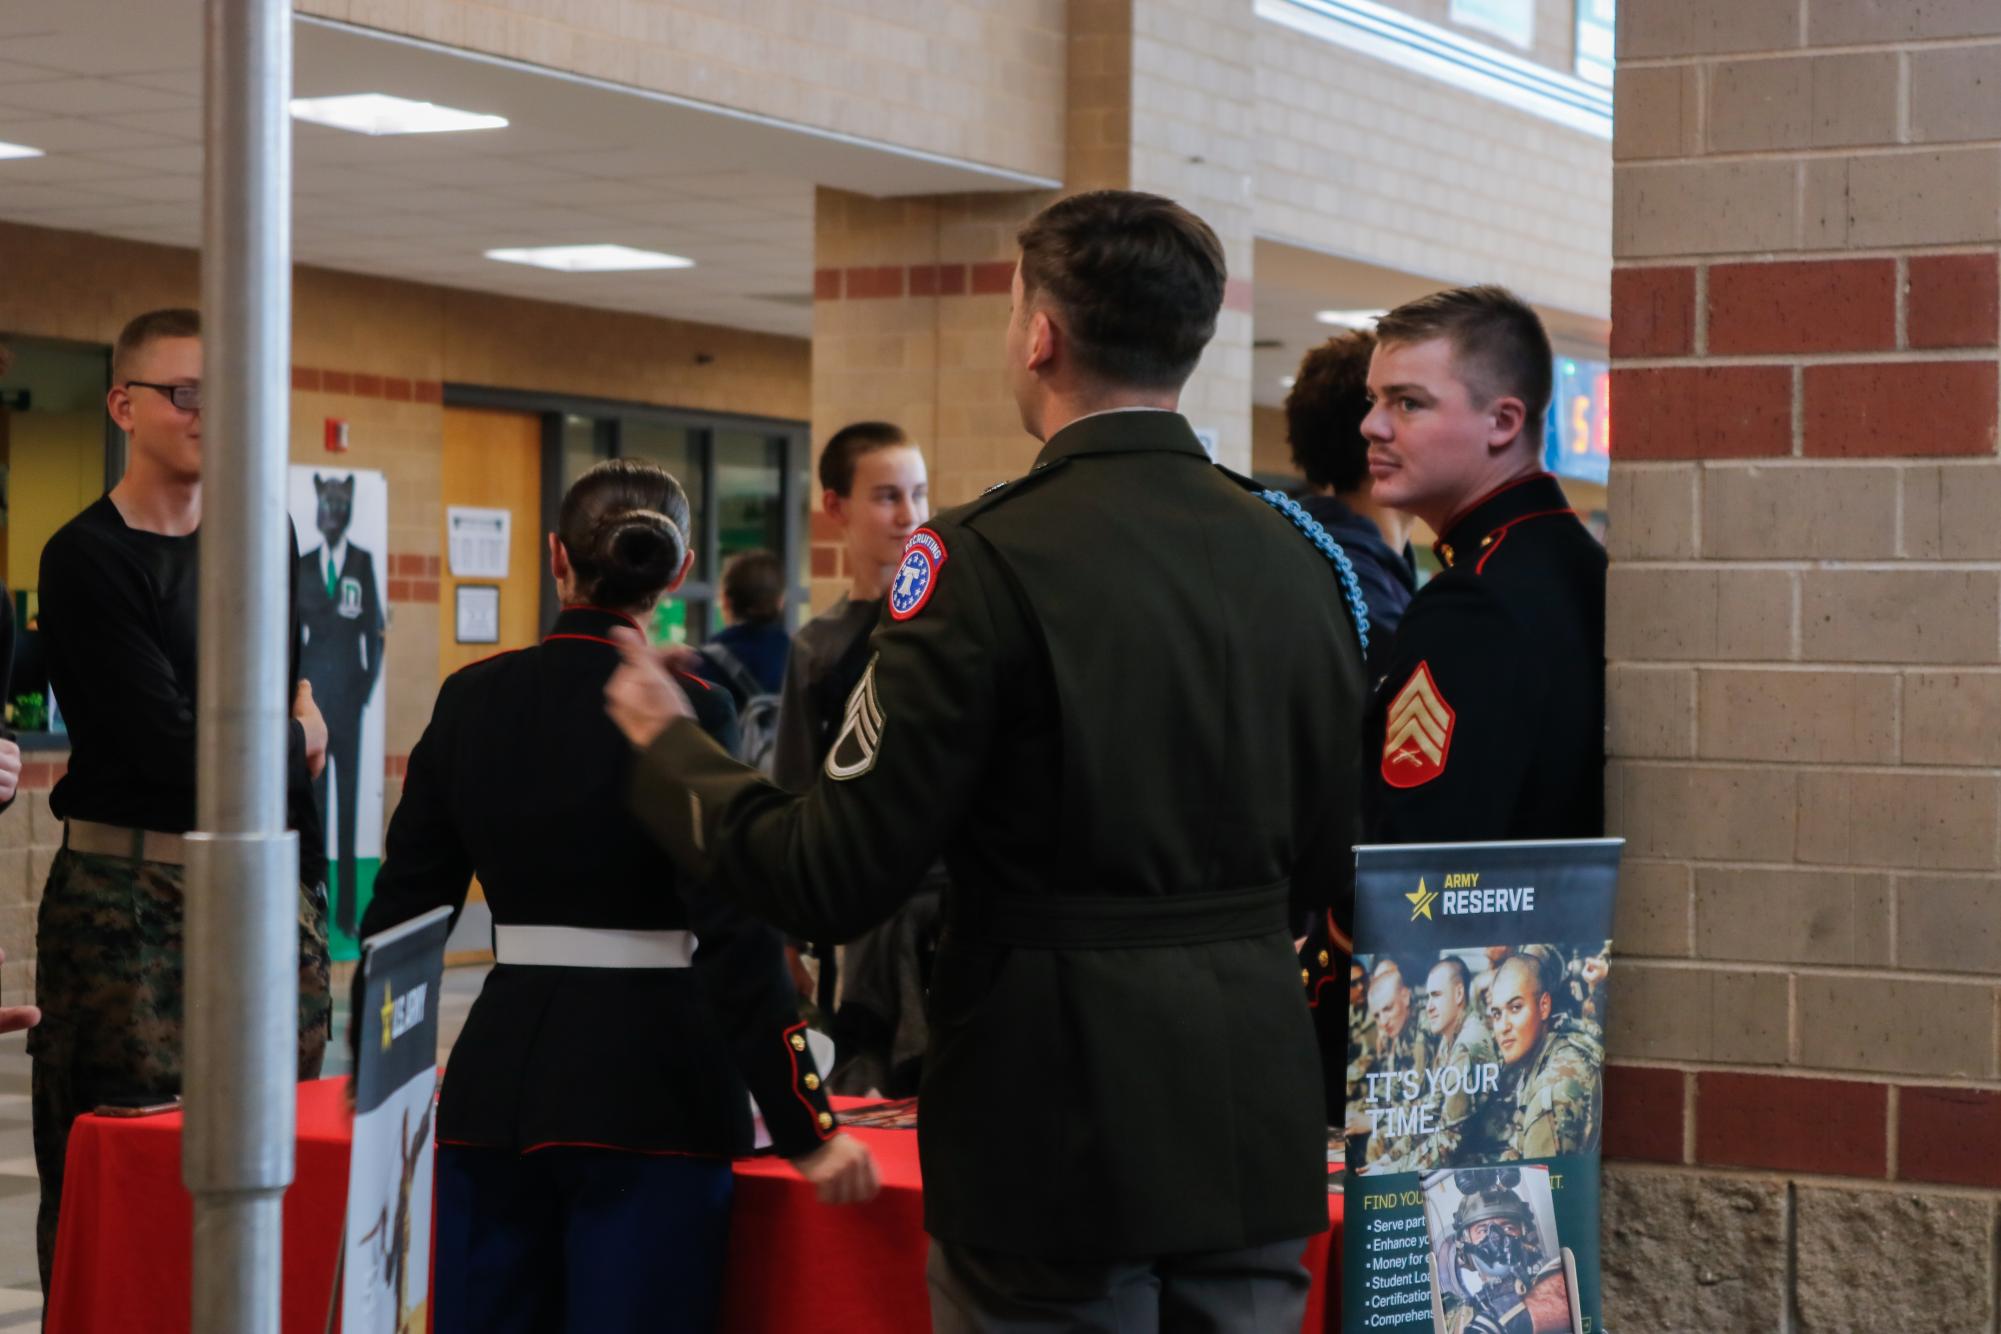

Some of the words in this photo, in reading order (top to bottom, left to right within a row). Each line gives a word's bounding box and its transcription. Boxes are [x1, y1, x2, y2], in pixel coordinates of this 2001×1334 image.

[1444, 873, 1479, 888] ARMY
[1443, 887, 1535, 915] RESERVE
[1366, 1069, 1420, 1103] IT'S
[1425, 1063, 1499, 1096] YOUR
[1364, 1193, 1397, 1210] FIND
[1373, 1219, 1404, 1233] Serve
[1373, 1237, 1417, 1251] Enhance
[1373, 1256, 1407, 1270] Money
[1409, 1252, 1423, 1265] for
[1372, 1274, 1412, 1290] Student
